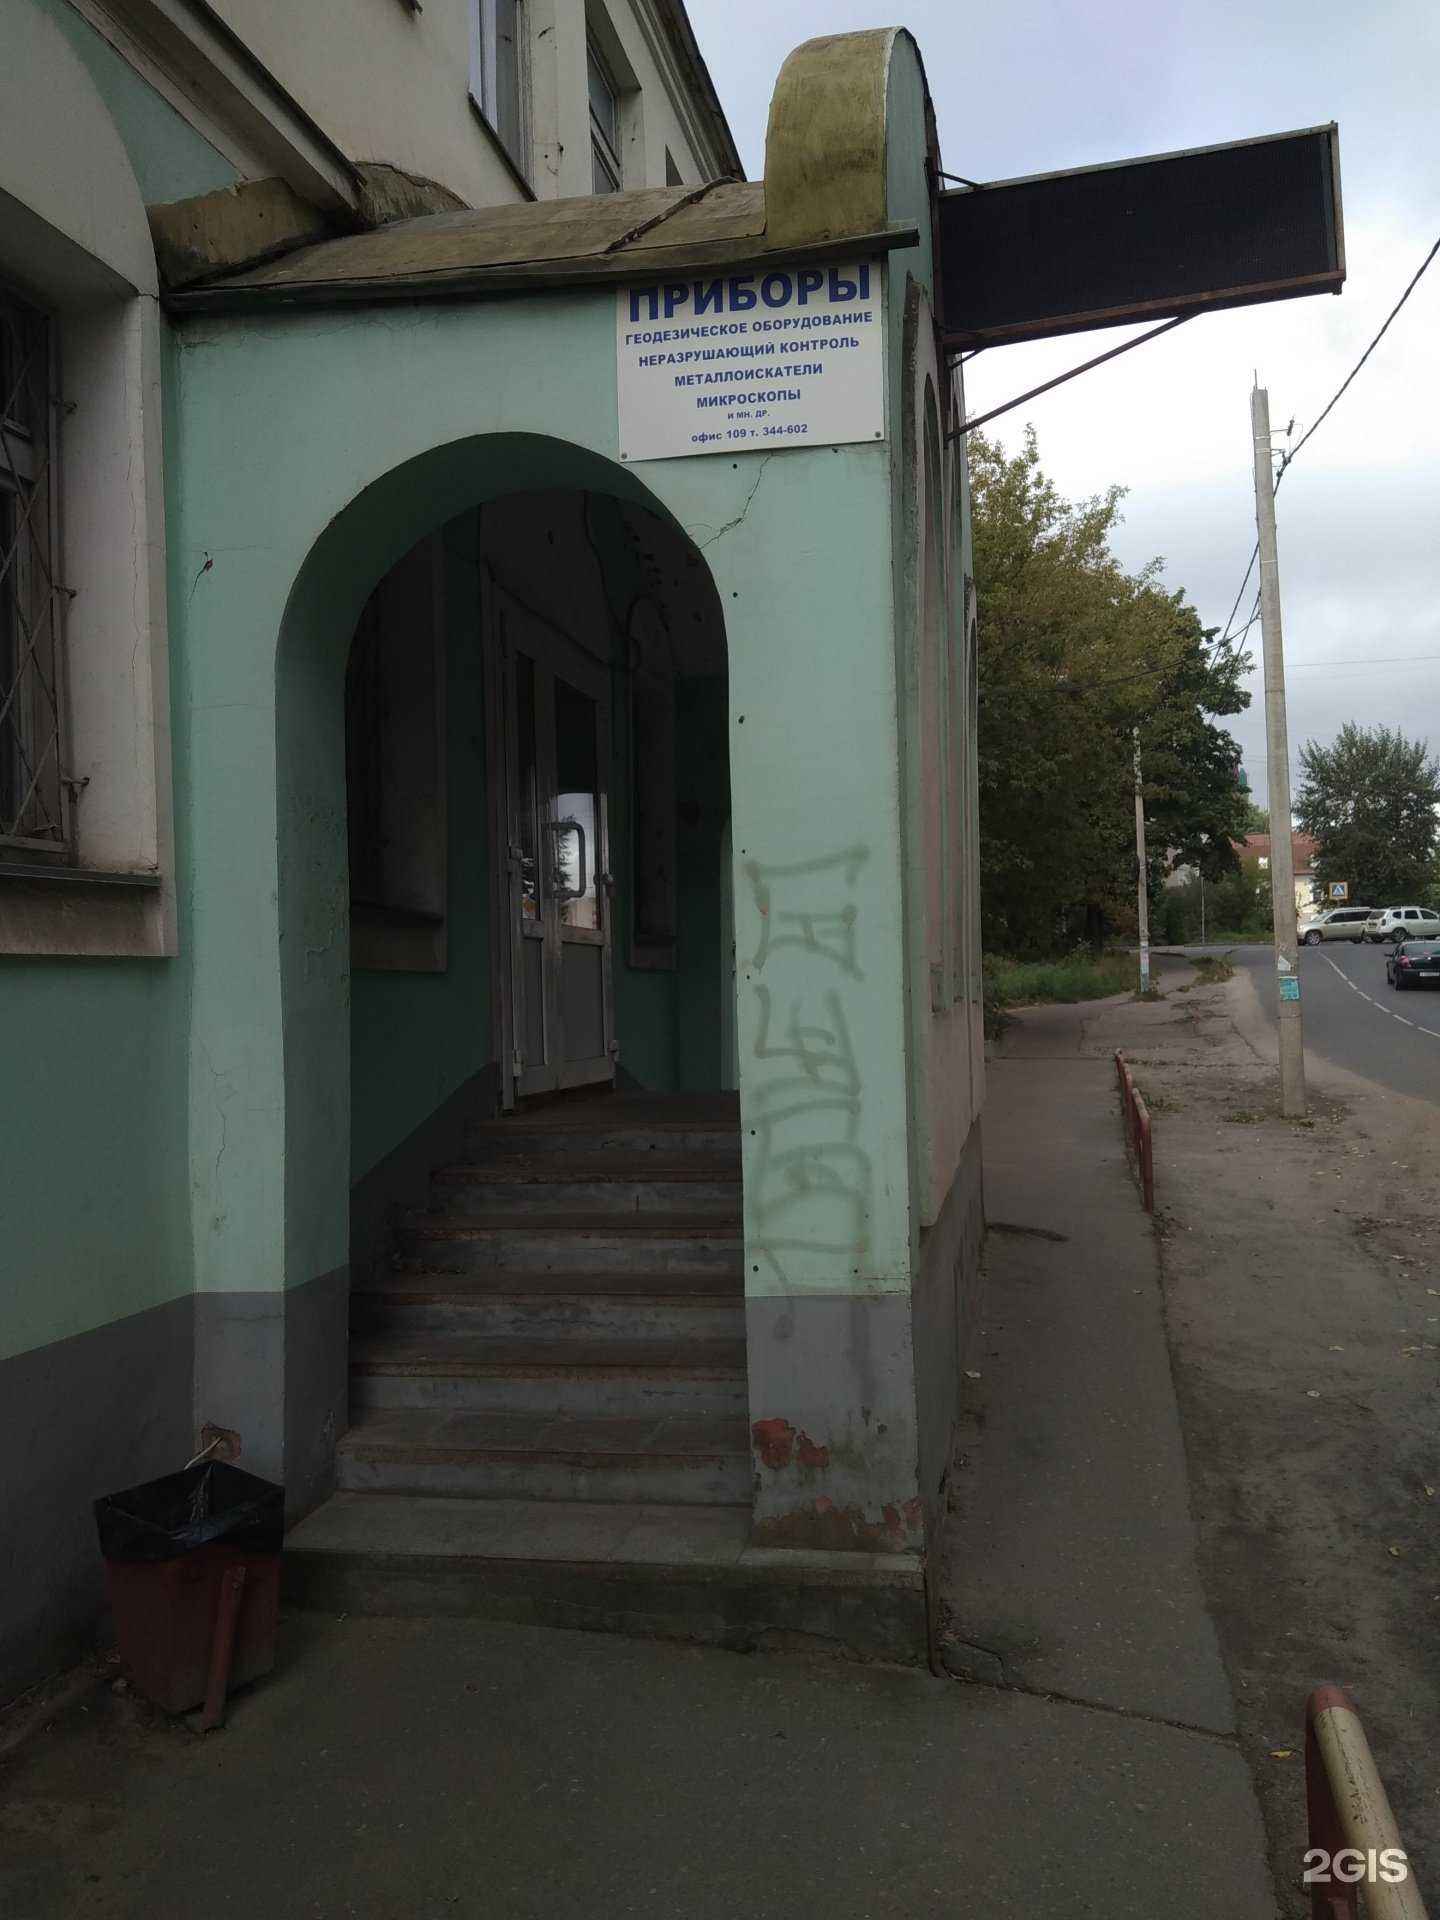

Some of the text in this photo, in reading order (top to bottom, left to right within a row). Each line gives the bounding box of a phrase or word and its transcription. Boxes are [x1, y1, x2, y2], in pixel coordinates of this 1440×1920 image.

[629, 265, 870, 322] ПРИБОРЫ
[625, 312, 873, 345] ГЕОДЕЗИЧЕСКОЕ ОБОРУДОВАНИЕ
[639, 337, 859, 366] НЕРАЗРУШАЮЩИЙ КОНТРОЛЬ
[674, 364, 823, 387] МЕТАЛЛОИСКАТЕЛИ
[697, 390, 801, 408] МИКРОСКОПЫ
[691, 424, 808, 443] офис 109 т. 344-602
